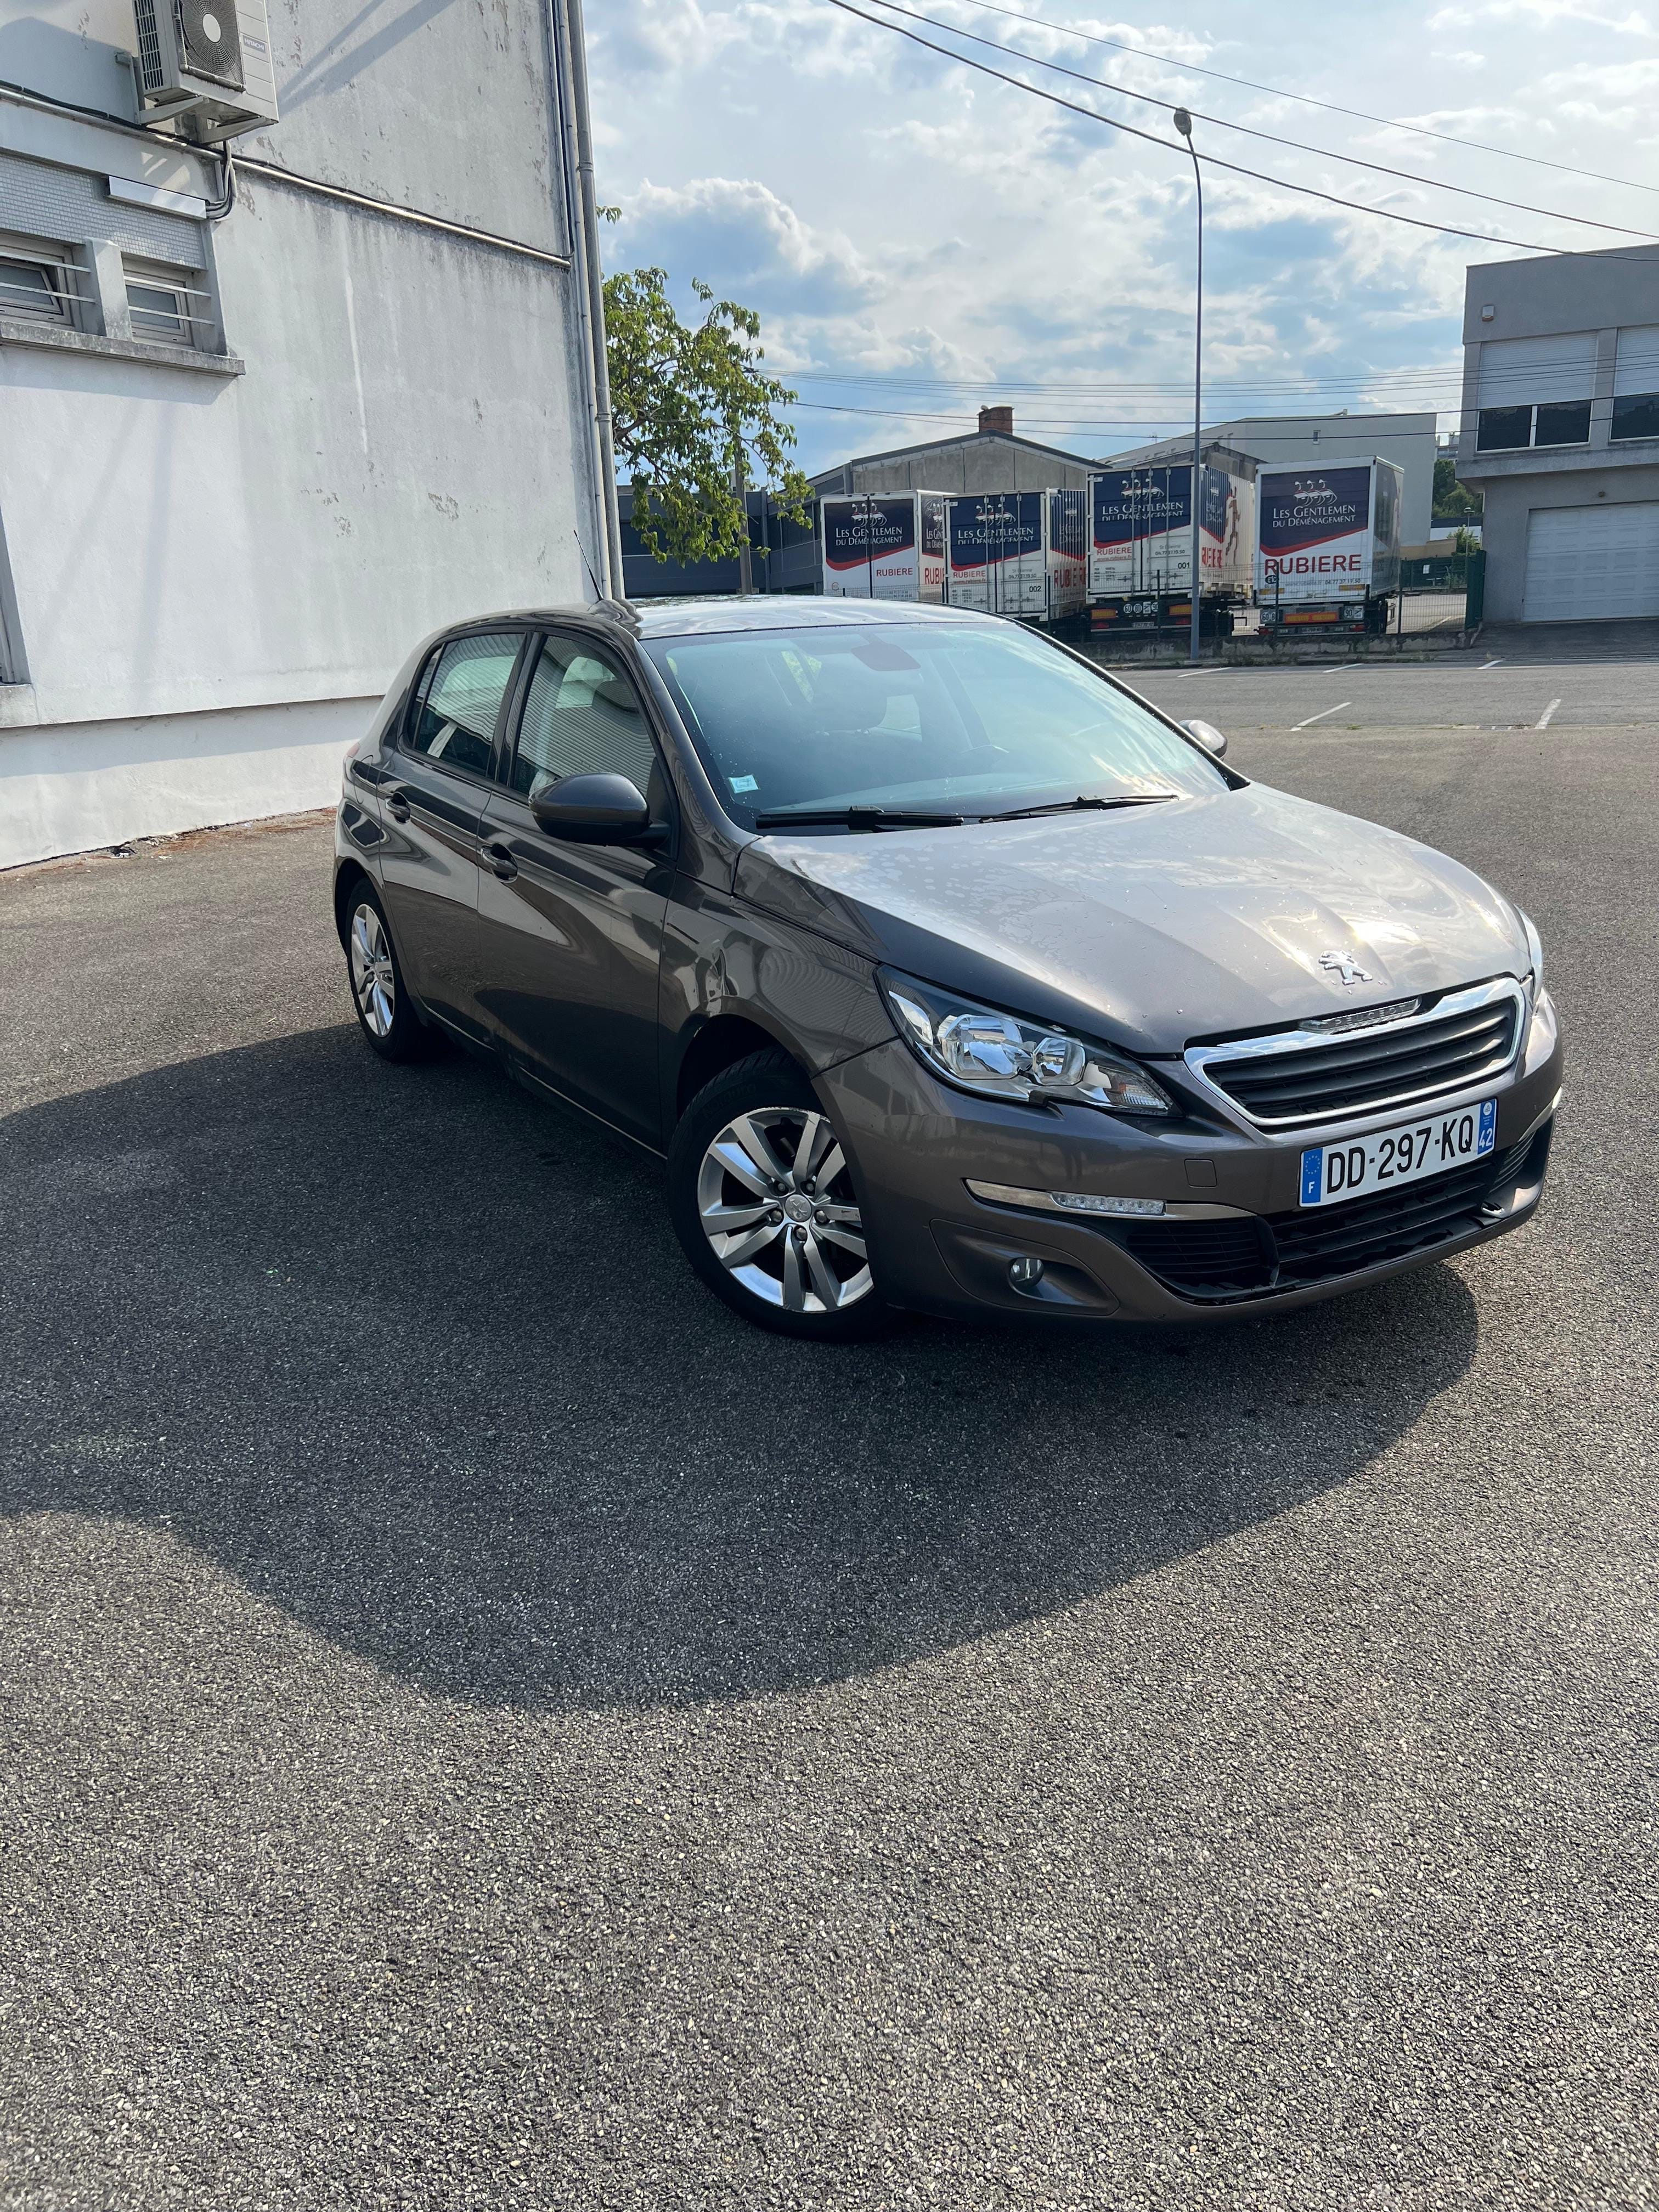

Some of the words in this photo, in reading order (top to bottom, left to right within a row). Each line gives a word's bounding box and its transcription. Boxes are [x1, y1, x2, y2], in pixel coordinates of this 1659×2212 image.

[1102, 505, 1119, 515] LES
[1122, 501, 1183, 514] GENTLEMEN
[1273, 508, 1289, 519] LES
[1294, 505, 1356, 517] GENTLEMEN
[1288, 515, 1356, 527] DÉMÉNAGEMENT
[836, 528, 849, 538] LES
[958, 530, 973, 539] LES
[977, 527, 1034, 538] GENTLEMEN
[1097, 546, 1132, 556] RUBIERE
[1265, 554, 1361, 575] RUBIERE
[877, 568, 913, 577] RUBIERE
[953, 570, 985, 578] RUBIERE
[1262, 613, 1269, 621] 60
[1345, 609, 1352, 618] 90
[1479, 1127, 1493, 1148] 42
[1327, 1115, 1474, 1194] DD-297-KQ
[1308, 1181, 1315, 1194] F
